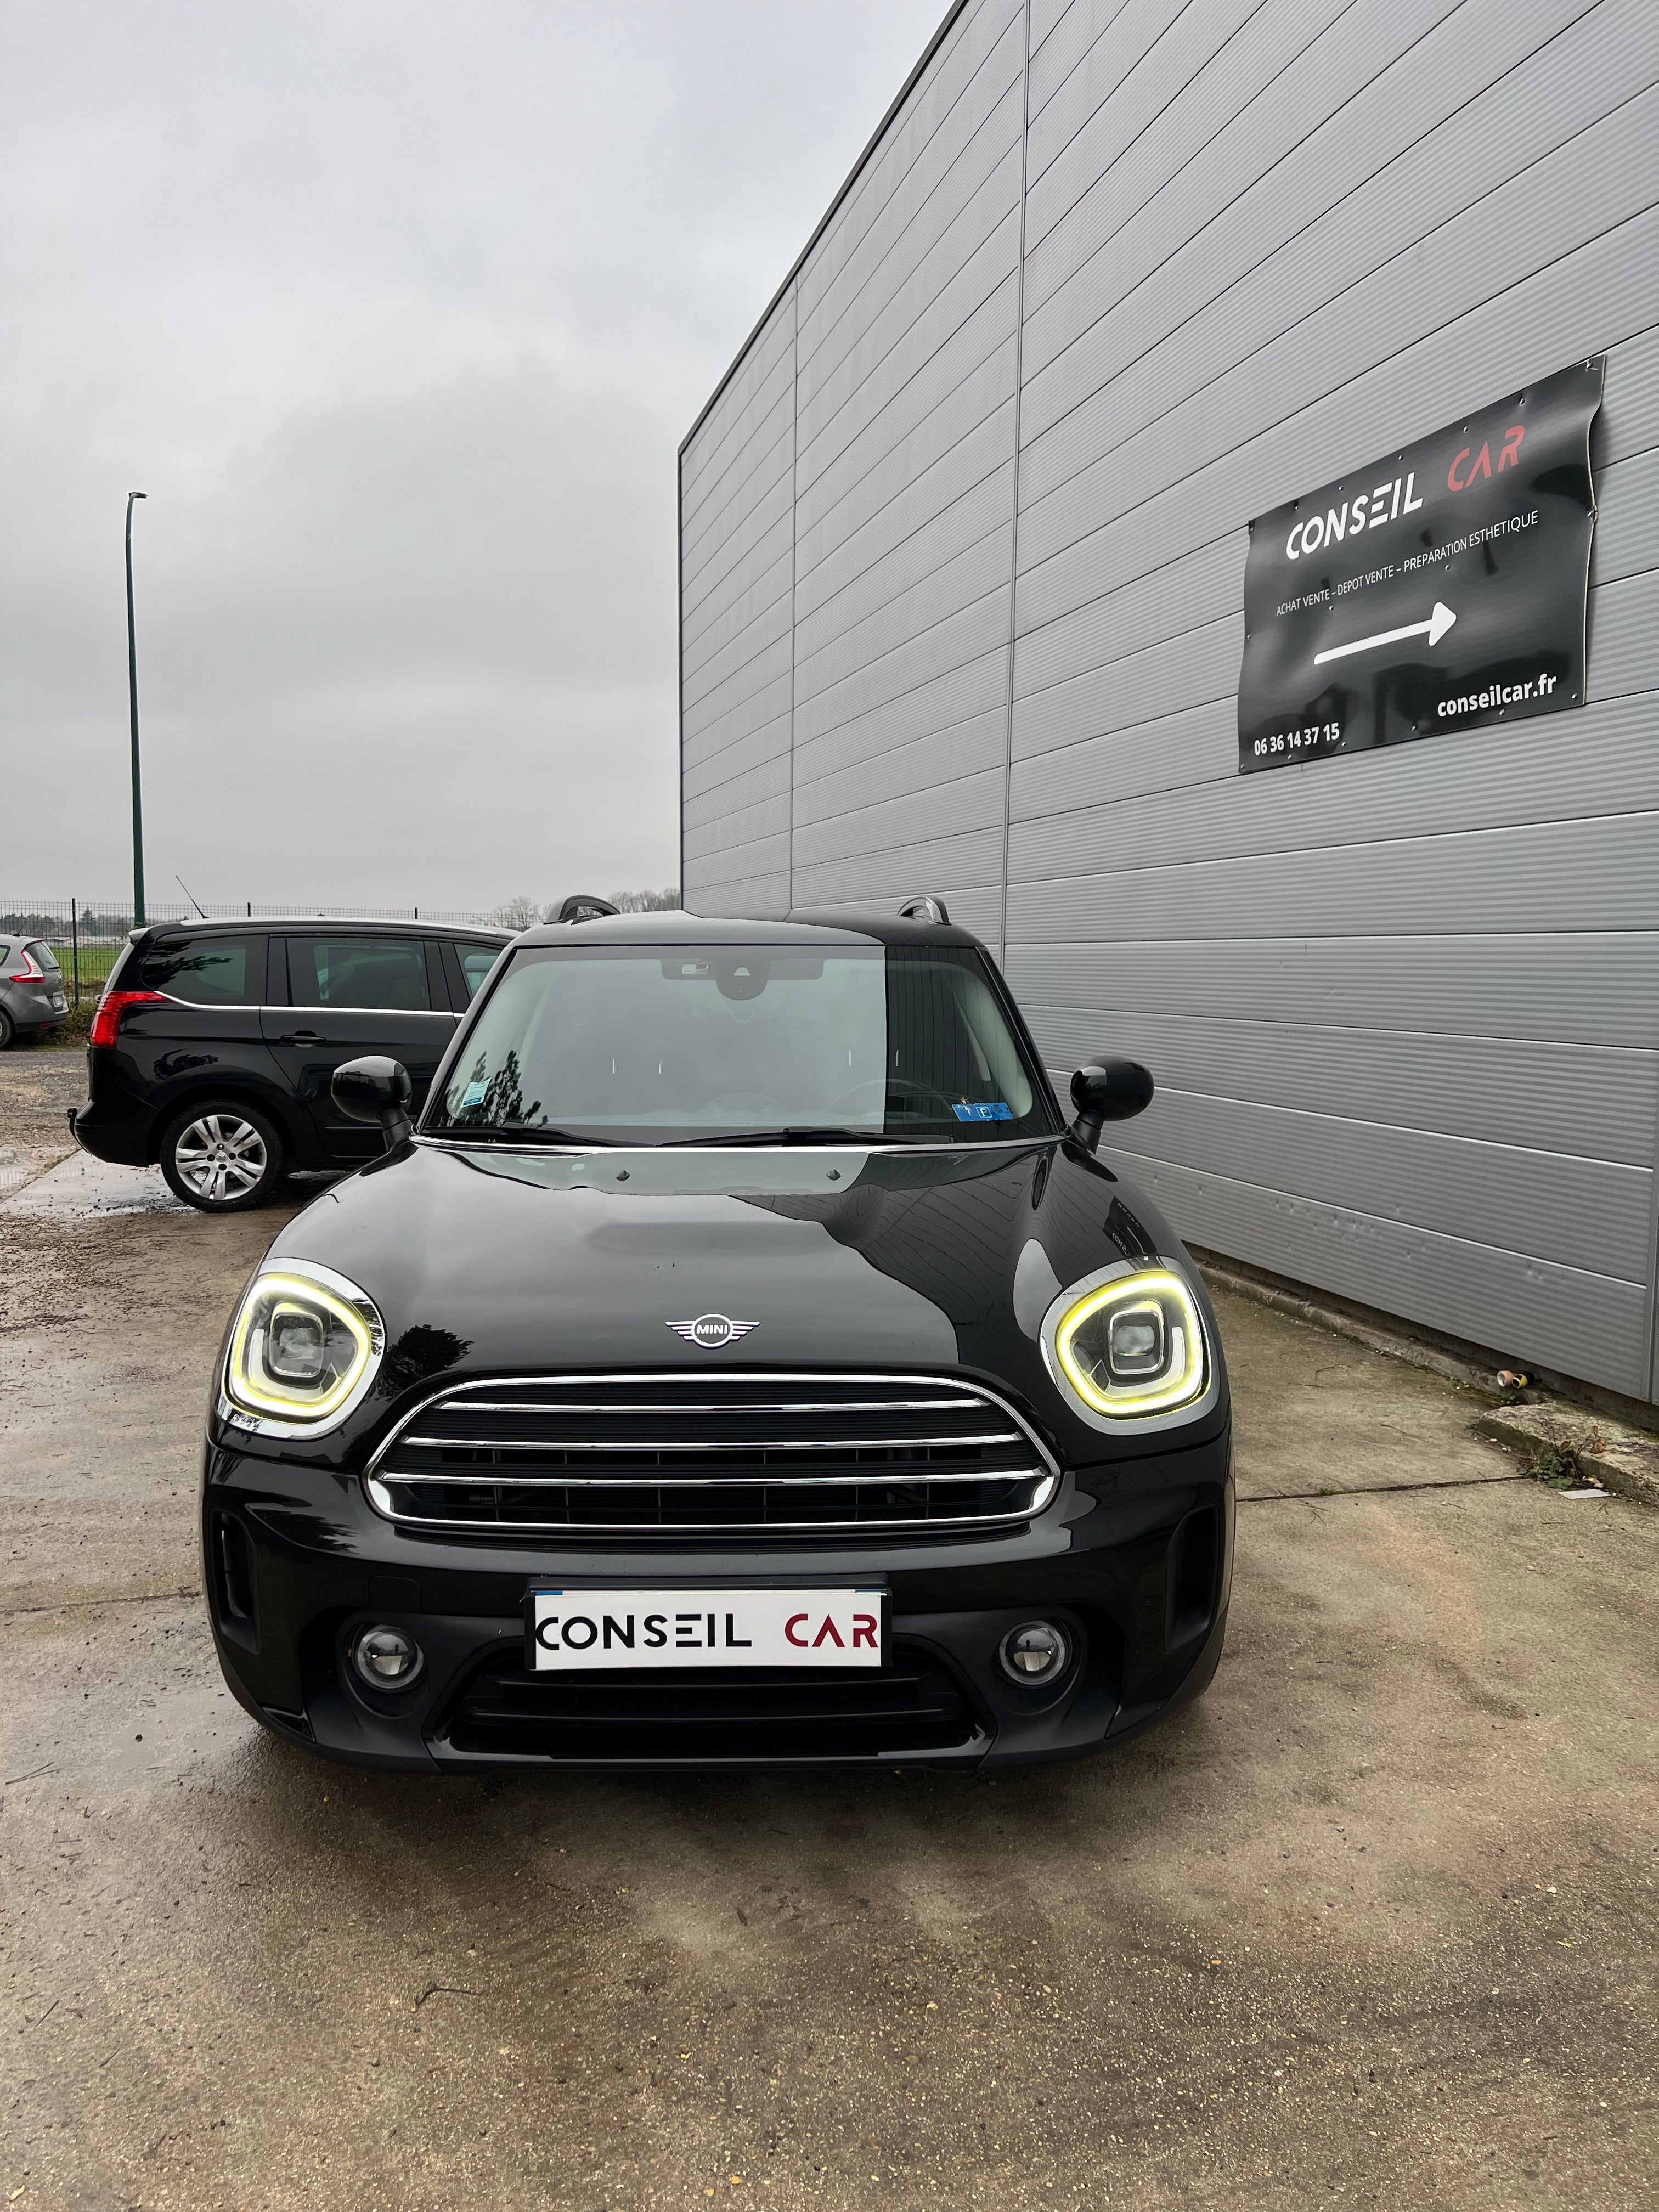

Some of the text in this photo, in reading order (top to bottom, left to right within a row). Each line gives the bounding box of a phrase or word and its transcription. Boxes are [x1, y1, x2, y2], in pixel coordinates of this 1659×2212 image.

[1286, 424, 1525, 560] CONSEIL CAR
[1276, 597, 1301, 617] ACHAT
[1302, 588, 1330, 607] VENTE
[1337, 575, 1364, 596] DEPOT
[1365, 565, 1394, 585] VENTE
[1404, 537, 1467, 572] PREPARATION
[1469, 510, 1539, 548] ESTHETIQUE
[1437, 673, 1557, 717] conseilcar.fr
[1254, 722, 1340, 755] 06 36 14 37 15
[697, 1324, 728, 1334] MINI
[535, 1613, 879, 1651] CONSEIL CAR
